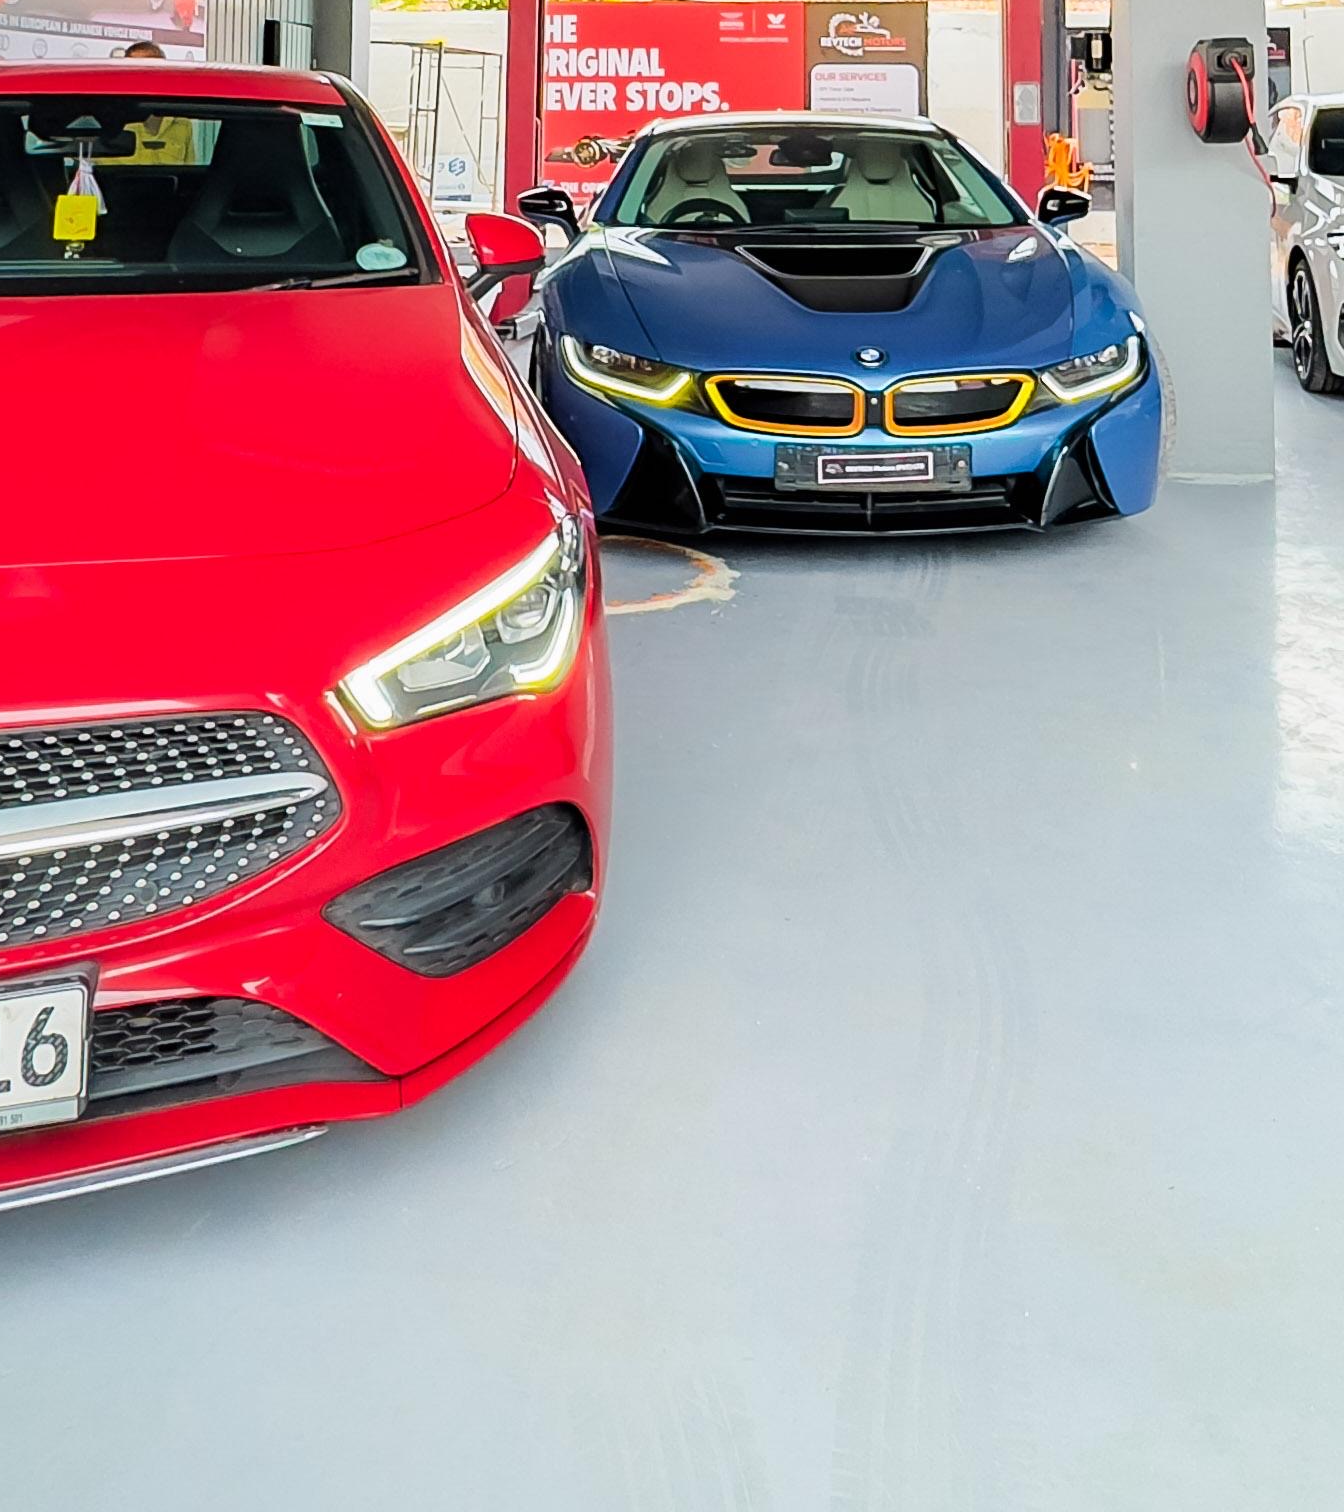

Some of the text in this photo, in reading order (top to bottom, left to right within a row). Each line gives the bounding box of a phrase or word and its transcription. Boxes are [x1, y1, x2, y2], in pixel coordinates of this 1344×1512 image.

[544, 15, 578, 44] HE
[544, 47, 666, 78] RIGINAL
[815, 73, 887, 82] OUR SERVICES
[544, 81, 730, 112] EVER STOPS.
